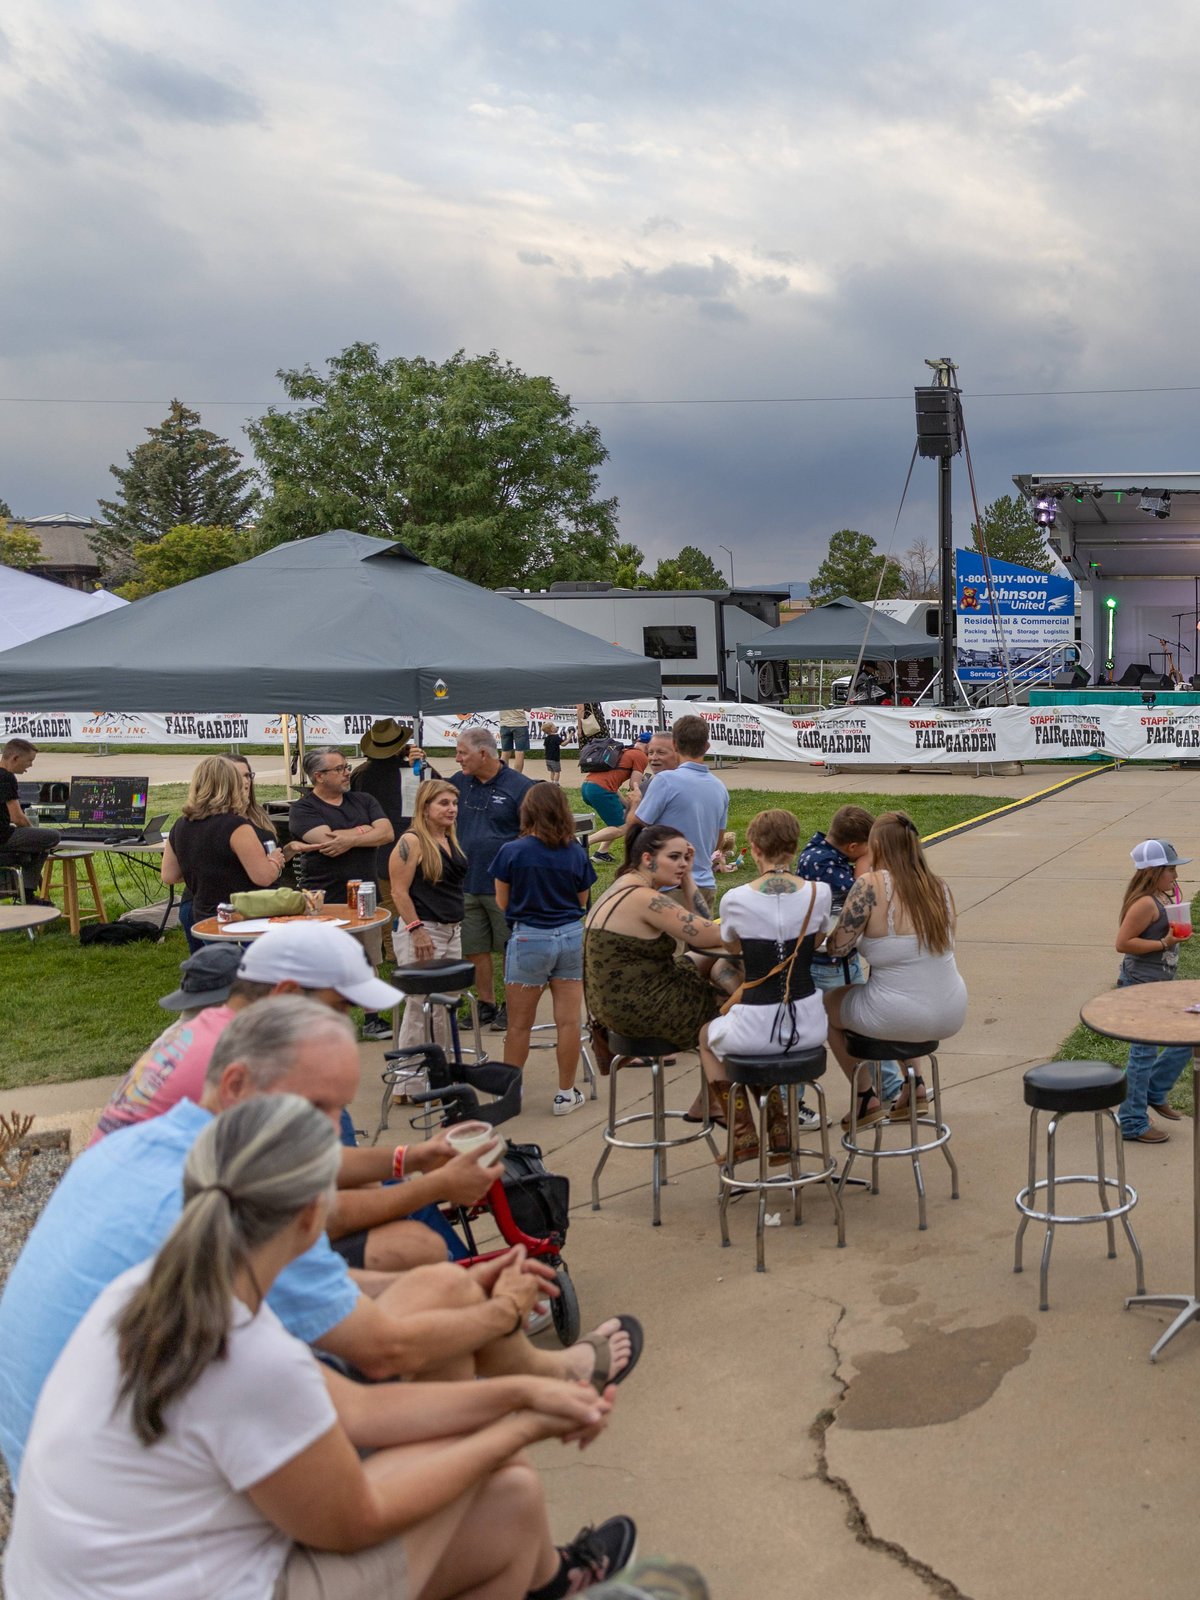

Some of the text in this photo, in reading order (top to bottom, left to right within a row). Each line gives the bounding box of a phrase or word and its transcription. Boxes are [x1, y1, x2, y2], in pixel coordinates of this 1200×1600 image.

[958, 574, 1048, 584] 1-800-BUY-MOVE
[979, 587, 1047, 600] Johnson
[1010, 600, 1046, 610] United
[1012, 617, 1019, 625] &
[1021, 617, 1070, 625] Commercial
[969, 671, 996, 679] Serving
[530, 711, 554, 720] STAPP
[611, 708, 633, 719] STAPP
[699, 712, 721, 722] STAPP
[344, 715, 373, 735] FAIR
[792, 719, 816, 730] STAPP
[908, 719, 937, 729] STAPP
[1029, 715, 1055, 725] STAPP
[1140, 716, 1169, 726] STAPP
[4, 716, 72, 738] FAIR GARDEN
[82, 726, 102, 734] B&B
[165, 716, 249, 739] FAIR GARDEN
[727, 727, 766, 749] GARDEN
[1035, 725, 1106, 748] FAIR GARDEN
[1146, 726, 1176, 744] FAIR
[796, 730, 871, 754] FAIR GARDEN
[915, 729, 997, 753] FAIR GARDEN
